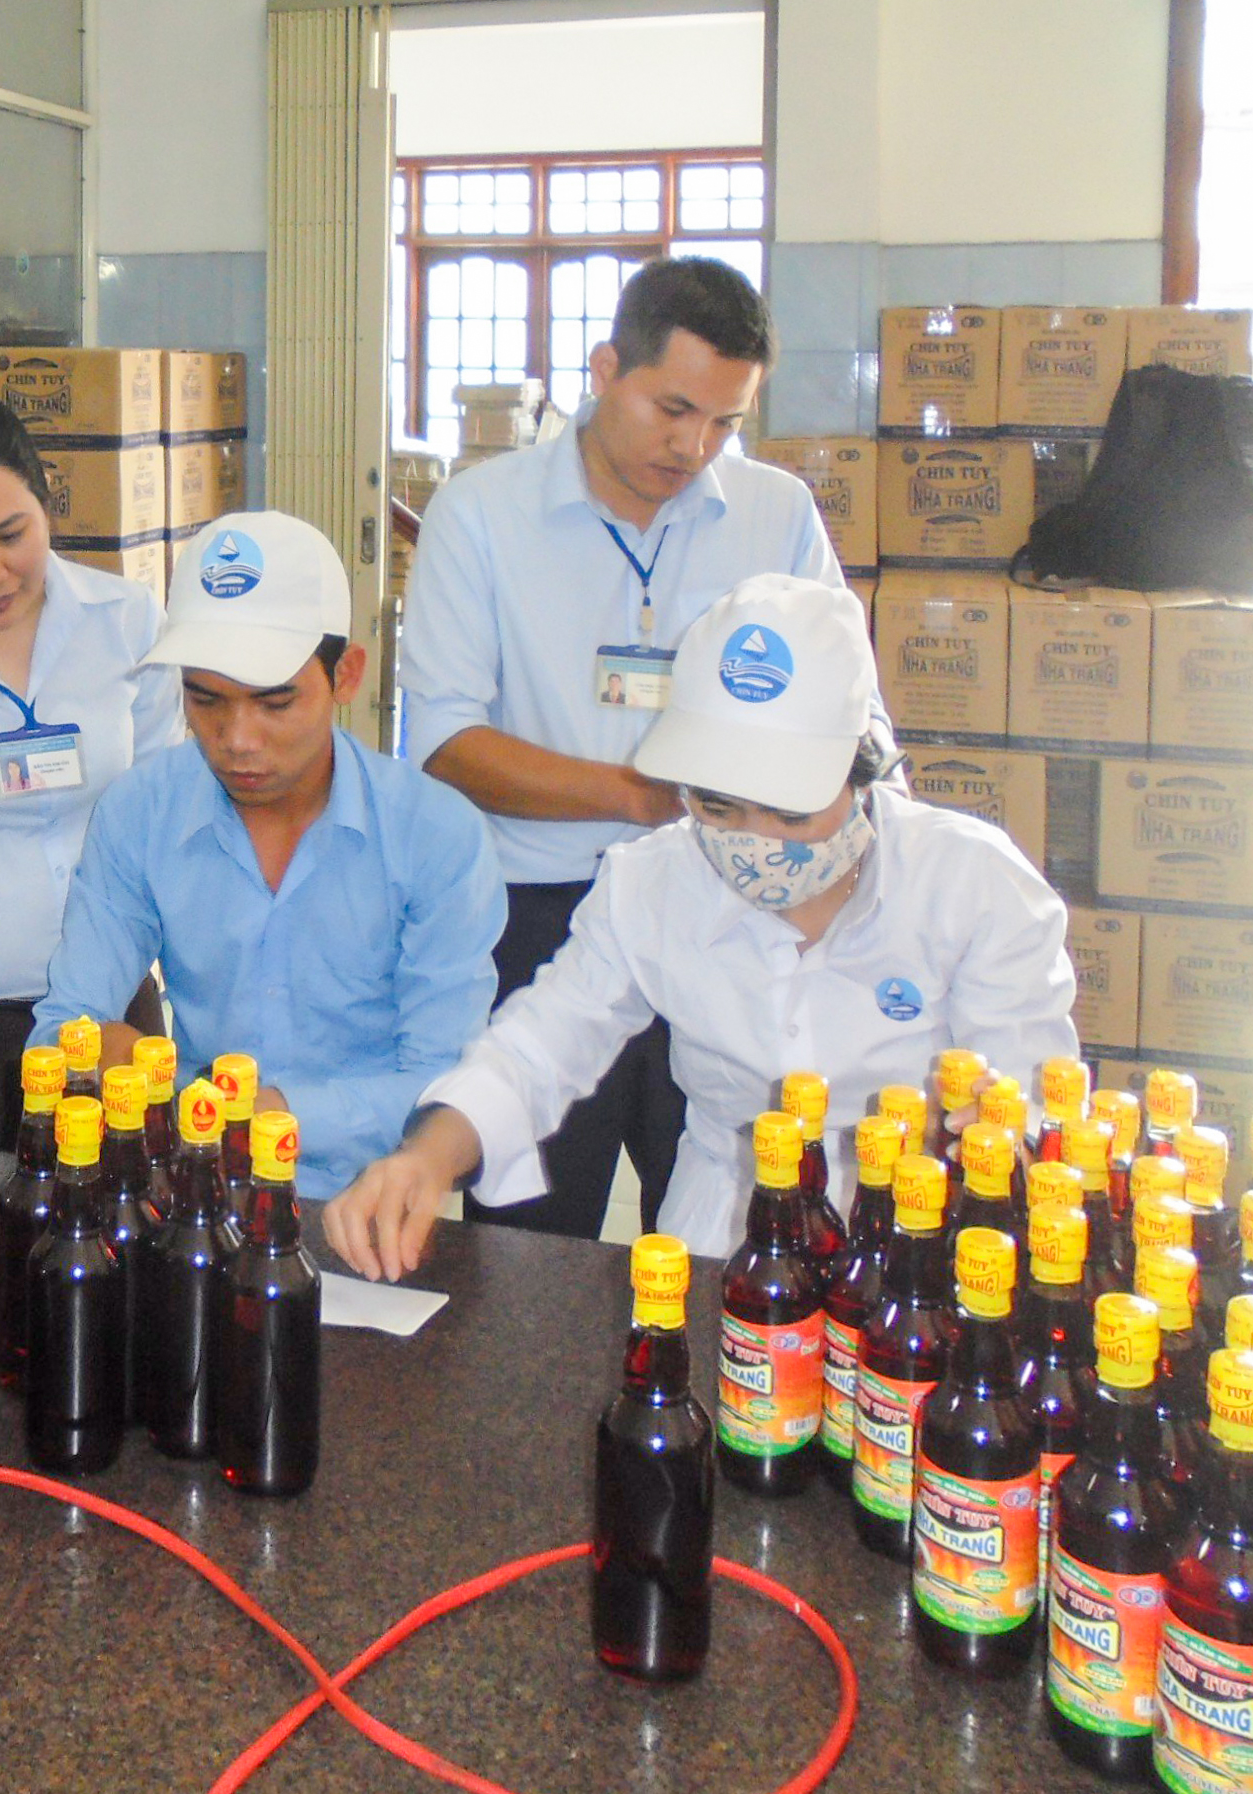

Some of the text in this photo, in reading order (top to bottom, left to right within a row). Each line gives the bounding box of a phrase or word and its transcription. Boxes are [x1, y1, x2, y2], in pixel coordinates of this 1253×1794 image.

[944, 343, 970, 353] TUY
[41, 374, 67, 385] TUY
[933, 359, 971, 381] TRANG
[30, 391, 70, 413] TRANG
[958, 467, 992, 480] TUY
[947, 485, 996, 511] TRANG
[944, 638, 973, 650] TUY
[1083, 643, 1112, 656] TUY
[931, 655, 975, 678] TRANG
[960, 782, 998, 796] TUY
[1199, 797, 1236, 812] TUY
[968, 1257, 989, 1272] TUY
[661, 1272, 682, 1283] TUY
[734, 1344, 769, 1365] TUY
[726, 1363, 766, 1390] TRANG
[1225, 1385, 1253, 1401] TUY
[954, 1507, 1001, 1529] TUY
[942, 1529, 996, 1557] TRANG
[1068, 1589, 1116, 1621] TUY
[1058, 1615, 1111, 1653] TRANG
[1200, 1670, 1253, 1701] TUY
[1185, 1695, 1251, 1734] TRANG
